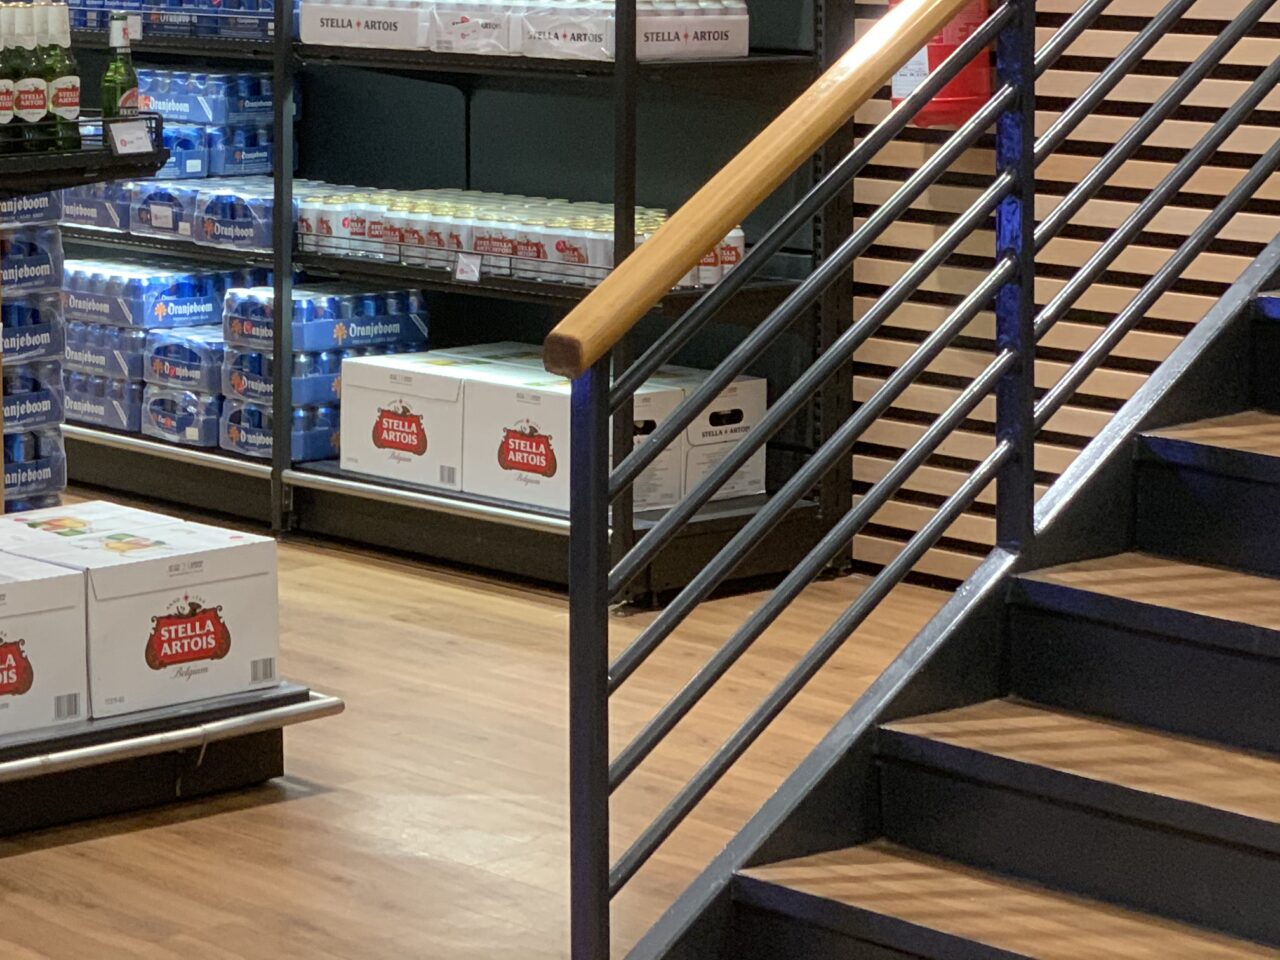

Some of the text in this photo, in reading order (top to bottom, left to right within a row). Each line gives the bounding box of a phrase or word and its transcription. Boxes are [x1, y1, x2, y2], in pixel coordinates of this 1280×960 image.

[319, 17, 399, 32] STELLA ARTOIS
[569, 32, 604, 43] ARTOIS
[643, 30, 730, 43] STELLA ARTOIS
[149, 96, 190, 113] Oranjeboom
[68, 295, 110, 313] Oranjeboom
[167, 301, 213, 316] Oranjeboom
[349, 322, 401, 339] Oranjeboom
[65, 345, 106, 366] Oranjeboom
[64, 395, 105, 416] Oranjeboom
[381, 417, 418, 434] STELLA
[701, 429, 723, 439] STELLA
[381, 429, 418, 446] ARTOIS
[508, 437, 546, 454] STELLA
[507, 450, 547, 467] ARTOIS
[160, 619, 215, 641] STELLA
[160, 634, 217, 657] ARTOIS
[170, 664, 210, 681] Belgium
